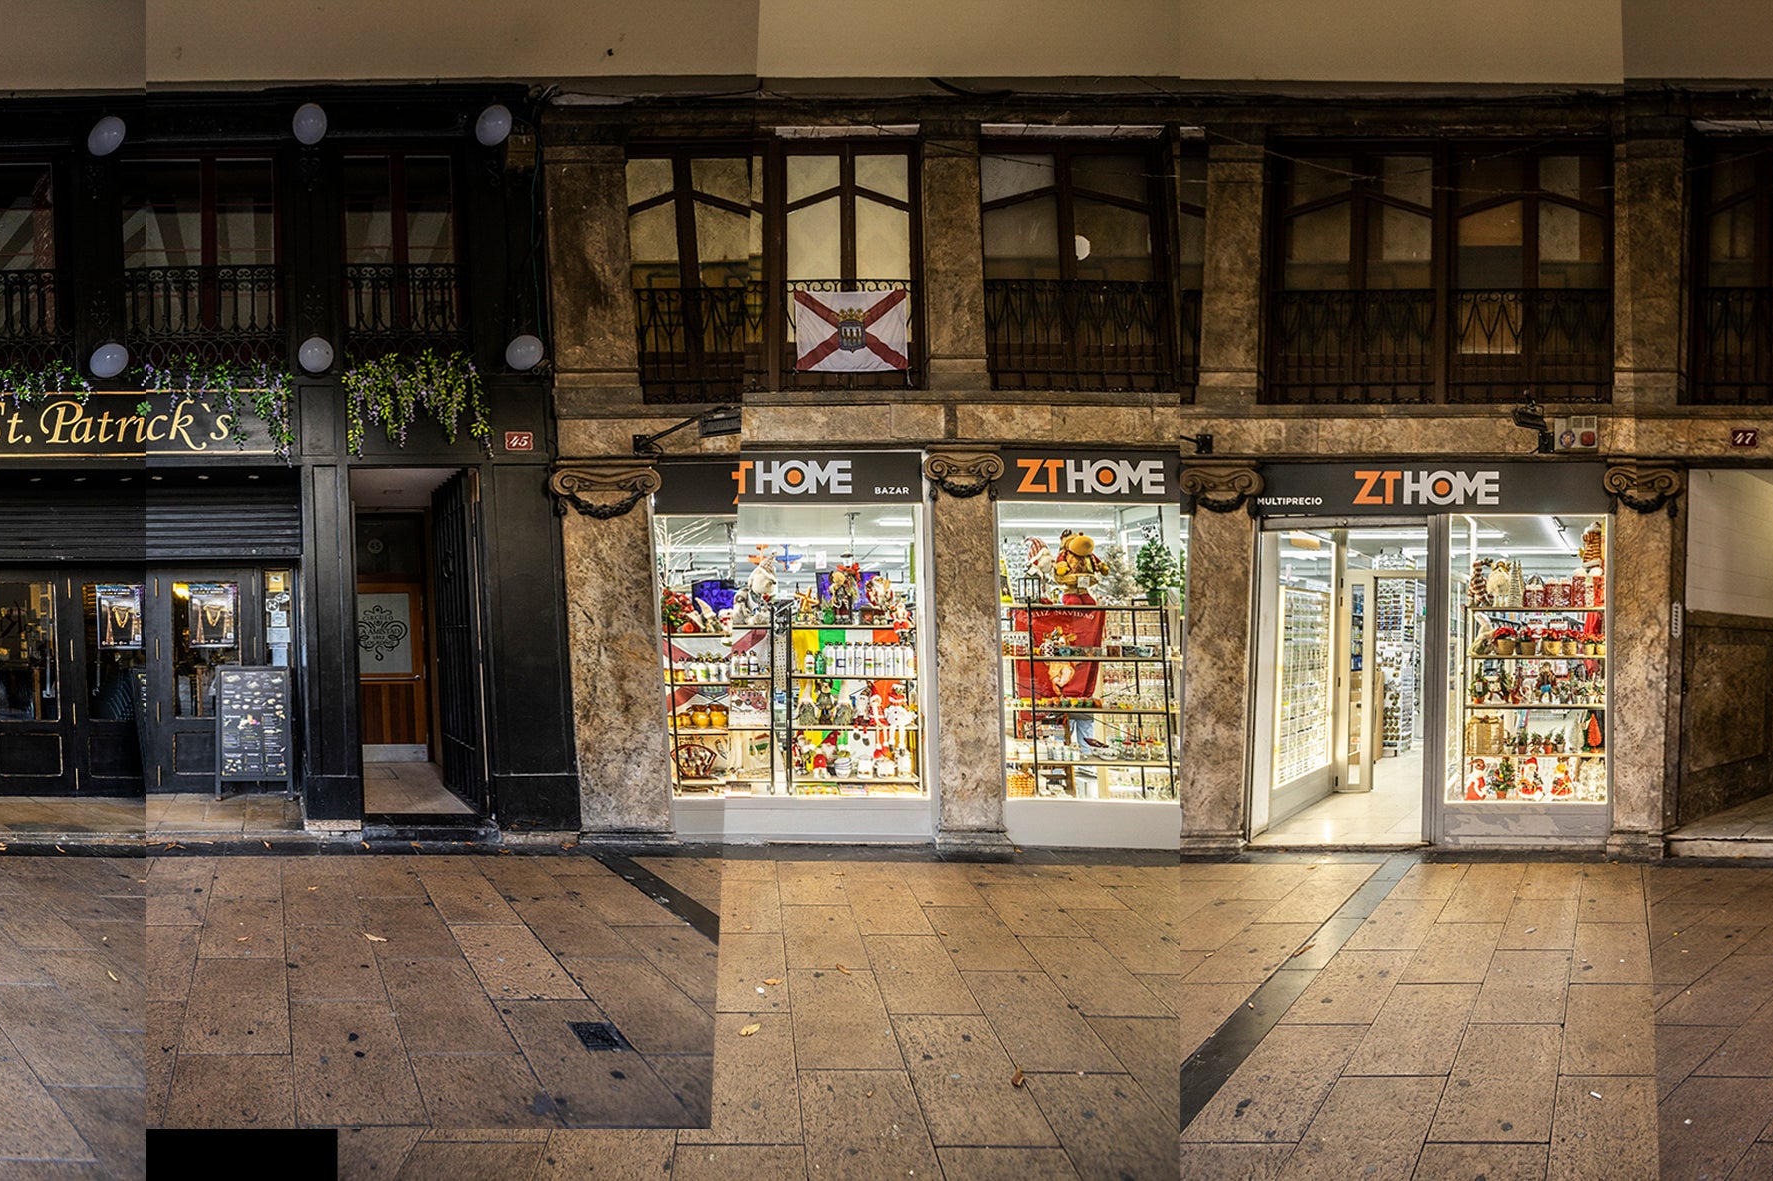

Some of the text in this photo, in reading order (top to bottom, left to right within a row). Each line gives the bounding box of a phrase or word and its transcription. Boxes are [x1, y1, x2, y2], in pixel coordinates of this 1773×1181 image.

[509, 435, 529, 447] 45
[1734, 432, 1755, 445] 47
[874, 486, 910, 495] BAZAR
[1257, 496, 1323, 506] MULTIPRECIO
